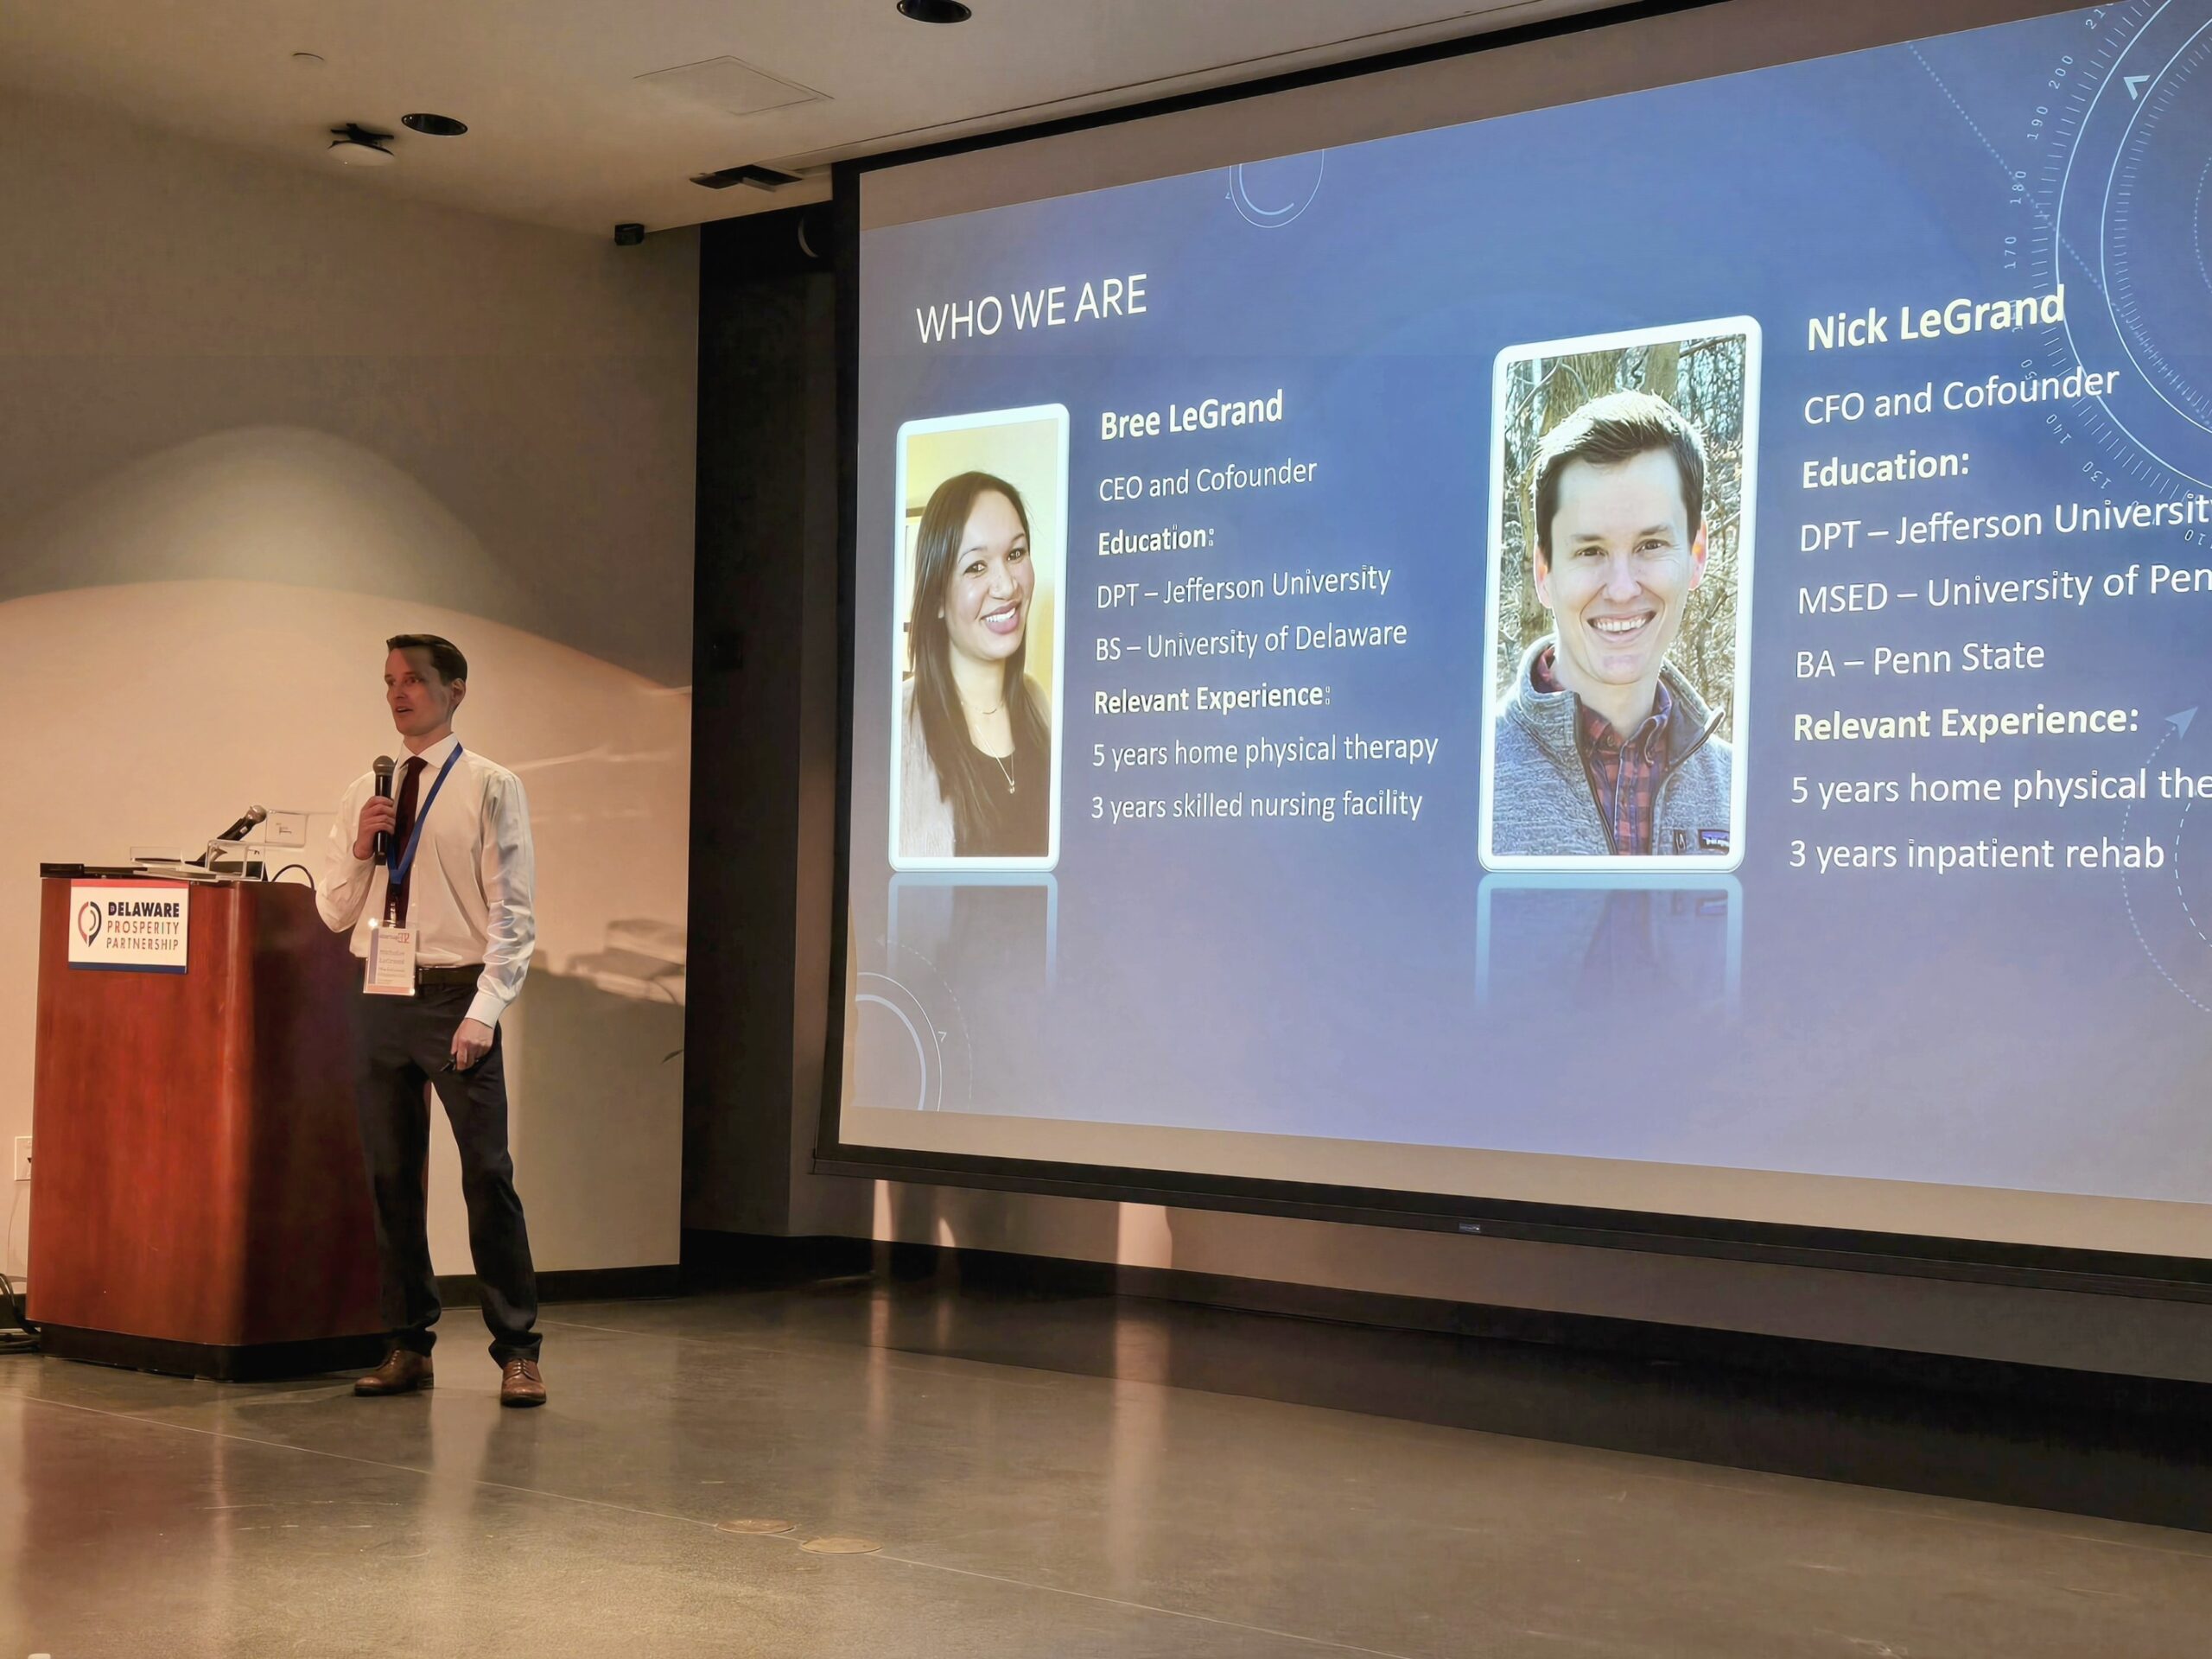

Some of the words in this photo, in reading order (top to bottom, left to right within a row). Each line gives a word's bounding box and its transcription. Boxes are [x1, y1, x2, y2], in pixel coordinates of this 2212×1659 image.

[2084, 2, 2114, 30] 21
[2048, 54, 2075, 91] 200
[2026, 105, 2050, 141] 190
[2009, 169, 2028, 206] 180
[2004, 236, 2018, 270] 170
[916, 296, 1003, 344] WHO
[1010, 286, 1067, 330] WE
[1074, 273, 1148, 322] ARE
[1808, 307, 1889, 352] Nick
[1900, 283, 2066, 340] LeGrand
[1804, 391, 1865, 426] CFO
[1874, 382, 1932, 418] and
[1943, 365, 2120, 411] Cofounder
[1100, 411, 1160, 441] Bree
[1170, 389, 1284, 433] LeGrand
[1099, 475, 1143, 502] CEO
[1149, 469, 1190, 496] and
[1196, 458, 1318, 493] Cofounder
[1802, 450, 1970, 489] Education:
[1098, 524, 1215, 556] Education:
[1800, 520, 1861, 552] DPT
[1896, 511, 2043, 545] Jefferson
[2055, 493, 2212, 533] Universit
[1096, 583, 1140, 610] DPT
[1163, 577, 1264, 606] Jefferson
[1272, 564, 1392, 595] University
[1798, 582, 1888, 614] MSED
[1929, 570, 2092, 606] University
[2102, 563, 2139, 596] of
[1096, 637, 1122, 662] BS
[1147, 629, 1259, 659] University
[1264, 625, 1289, 652] of
[1295, 622, 1408, 650] Delaware
[1796, 650, 1836, 678] BA
[1874, 646, 1951, 676] Penn
[1961, 641, 2045, 671] State
[1095, 689, 1190, 715] Relevant
[1197, 683, 1331, 716] Experience:
[1794, 710, 1931, 741] Relevant
[1942, 703, 2139, 744] Experience:
[1092, 743, 1105, 767] 5
[1112, 745, 1167, 772] years
[1174, 739, 1239, 766] home
[1245, 734, 1337, 768] physical
[1344, 734, 1440, 766] therapy
[1091, 795, 1104, 820] 3
[1110, 798, 1166, 825] years
[1173, 791, 1243, 819] skilled
[1250, 791, 1336, 823] nursing
[1343, 789, 1423, 822] facility
[1791, 776, 1808, 804] 5
[1818, 780, 1899, 810] years
[1910, 772, 2002, 802] home
[2013, 768, 2147, 808] physical
[2158, 766, 2212, 799] the
[1789, 840, 1806, 868] 3
[1816, 844, 1897, 874] years
[1908, 838, 2054, 875] inpatient
[2066, 836, 2165, 869] rehab
[107, 920, 180, 935] PROSPERITY
[108, 901, 180, 918] DELAWARE
[106, 938, 179, 950] PARTNERSHIP
